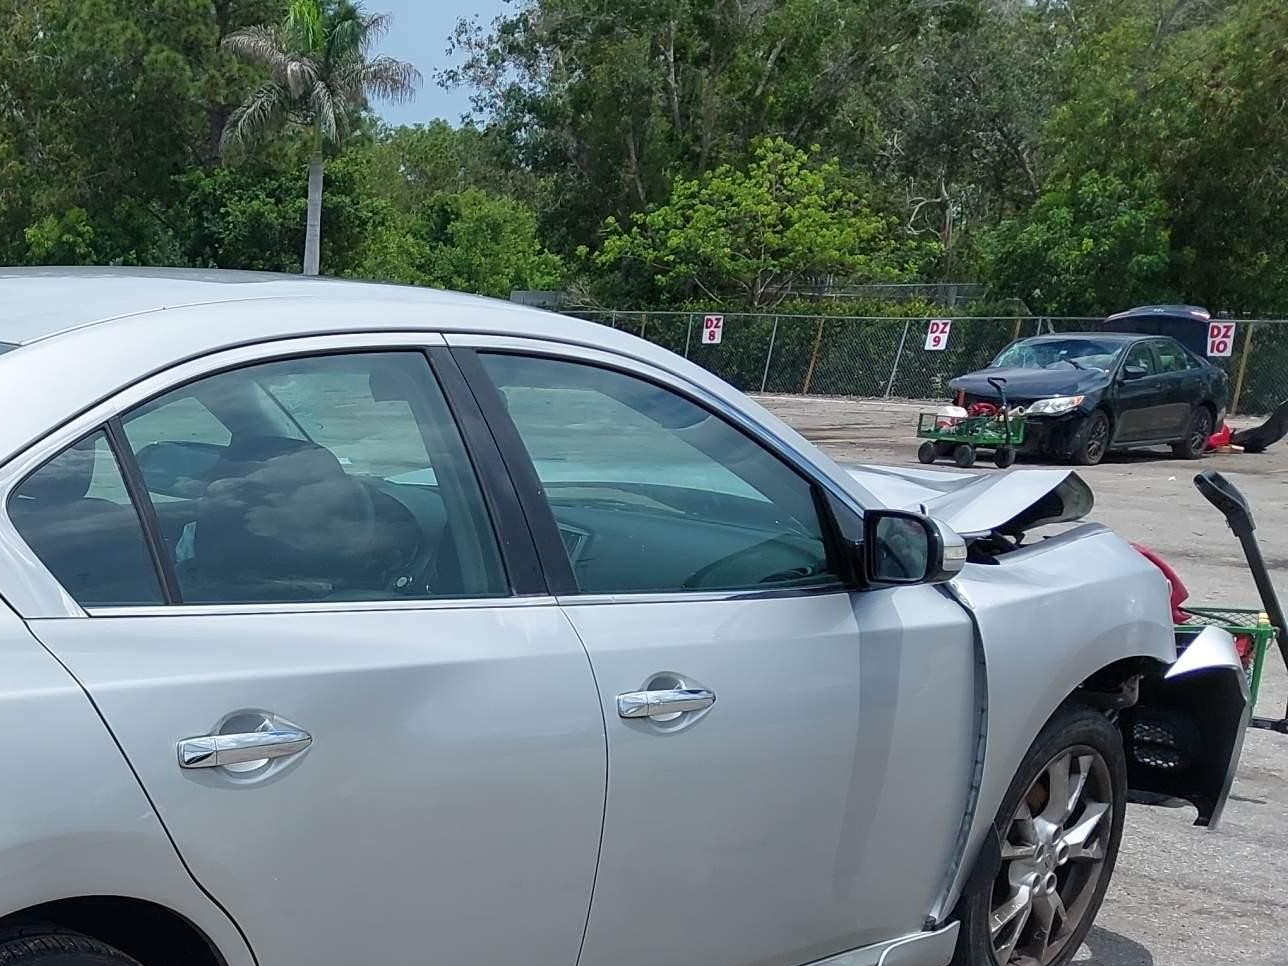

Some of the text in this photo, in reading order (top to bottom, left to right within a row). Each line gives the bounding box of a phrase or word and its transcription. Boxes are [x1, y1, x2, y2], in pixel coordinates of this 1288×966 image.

[705, 318, 722, 329] DZ
[930, 322, 949, 334] DZ
[708, 330, 716, 341] 8
[1210, 325, 1233, 339] DZ
[932, 335, 941, 347] 9
[1210, 340, 1227, 353] 10
